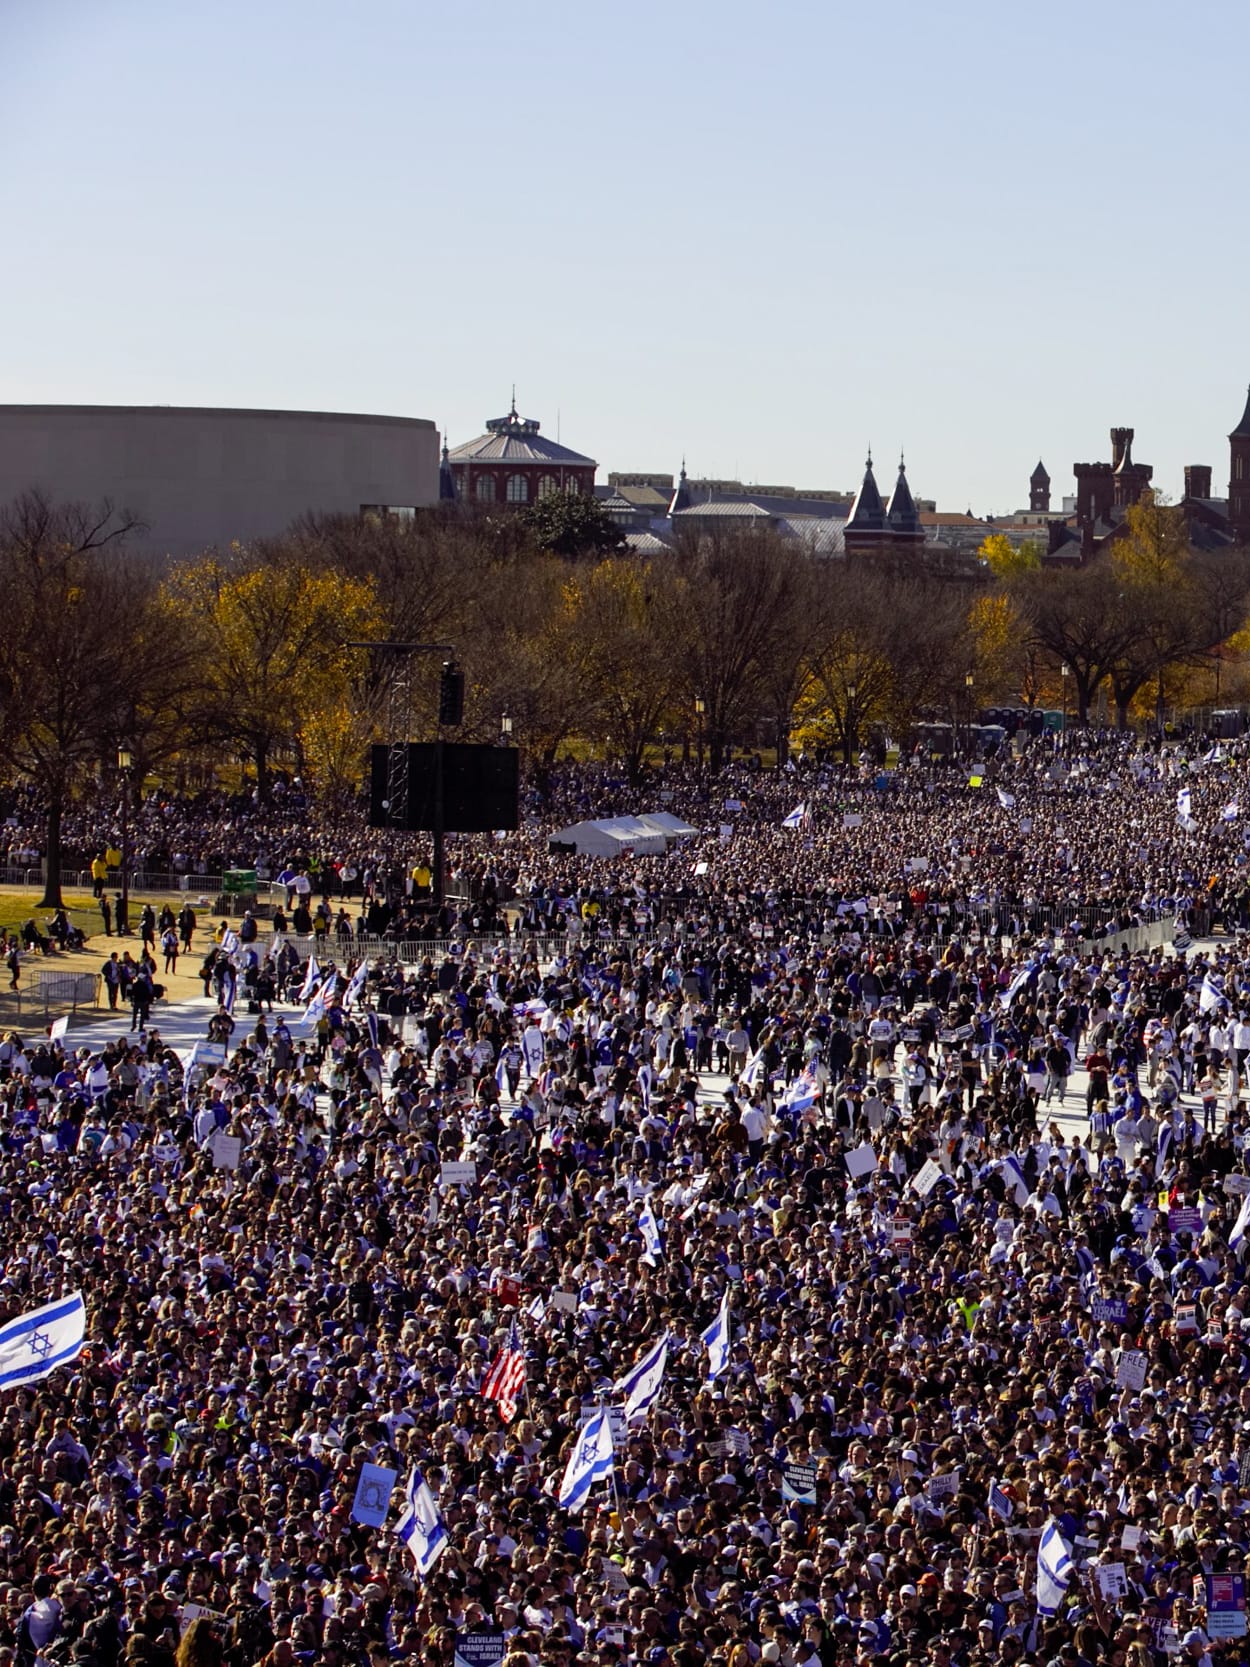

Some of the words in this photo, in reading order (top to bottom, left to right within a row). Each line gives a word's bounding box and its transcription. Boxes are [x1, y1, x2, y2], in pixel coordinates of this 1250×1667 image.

[1093, 1305, 1126, 1318] YISRAEL
[1121, 1352, 1145, 1369] FREE
[789, 1465, 815, 1475] CLEVELAND
[931, 1476, 953, 1488] PHILLY
[467, 1636, 503, 1644] CLEVELAND
[459, 1644, 484, 1652] STANDS
[479, 1652, 501, 1660] ISRAEL
